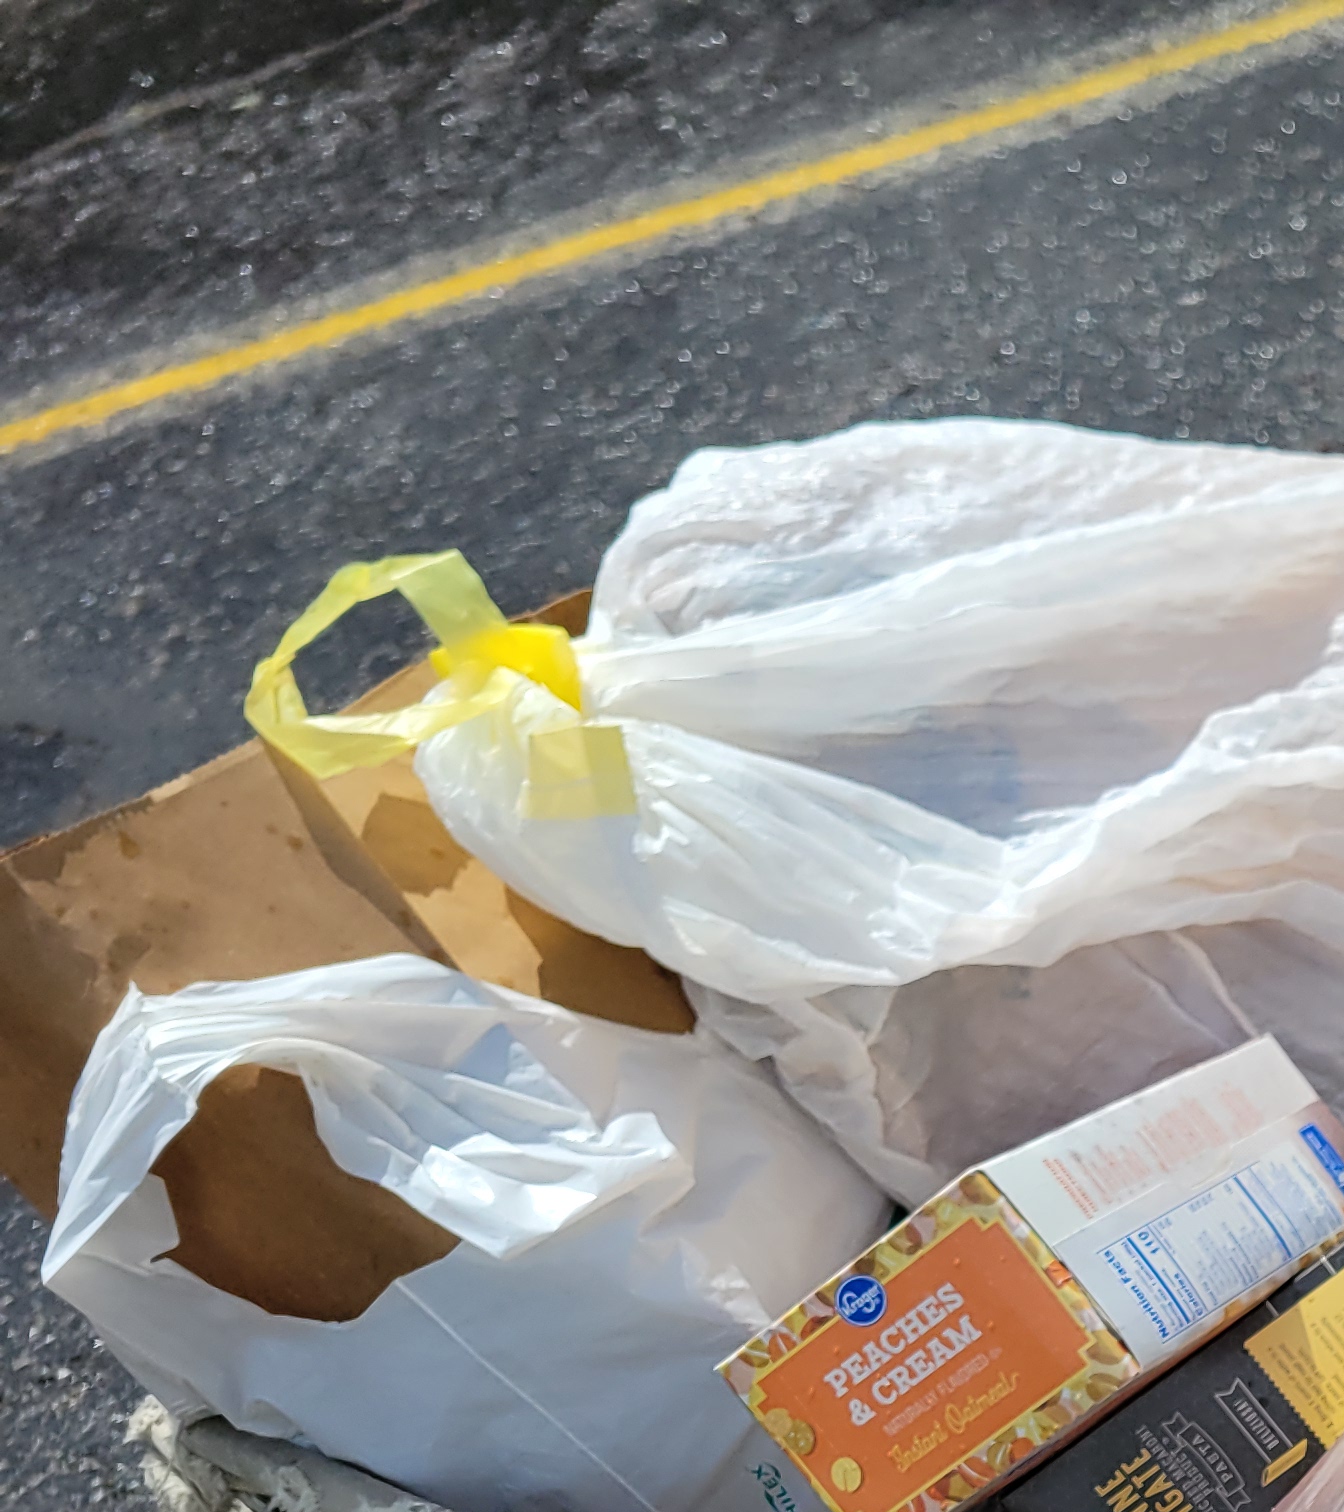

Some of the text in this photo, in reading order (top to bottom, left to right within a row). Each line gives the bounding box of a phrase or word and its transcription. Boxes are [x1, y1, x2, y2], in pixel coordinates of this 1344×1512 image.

[841, 1285, 882, 1319] Kroger
[1102, 1247, 1132, 1284] Facts
[824, 1282, 964, 1398] PEACHES
[1131, 1283, 1170, 1338] Nutrition
[848, 1315, 983, 1427] & CREAM
[888, 1371, 1020, 1473] Instant Oatmeal
